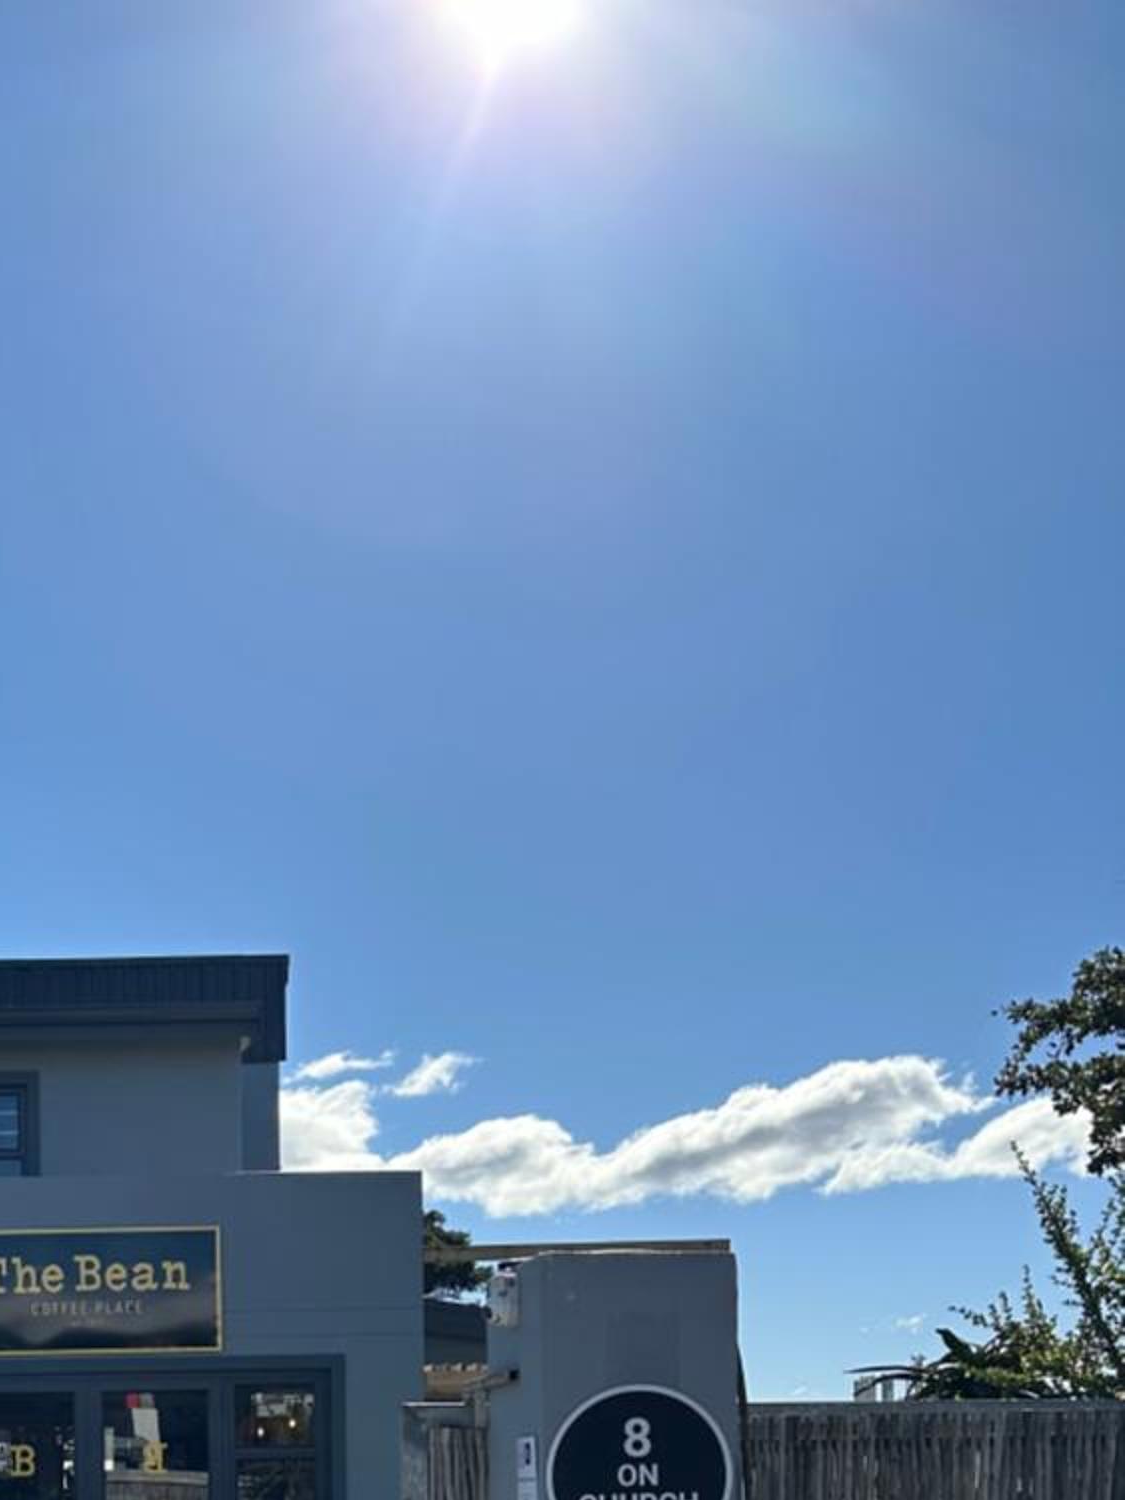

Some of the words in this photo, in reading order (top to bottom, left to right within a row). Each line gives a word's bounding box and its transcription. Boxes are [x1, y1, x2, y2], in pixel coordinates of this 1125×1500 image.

[73, 1254, 191, 1292] Bean
[30, 1300, 88, 1316] COFFEE
[94, 1298, 144, 1315] PLACE
[623, 1417, 652, 1458] 8
[617, 1463, 660, 1487] ON
